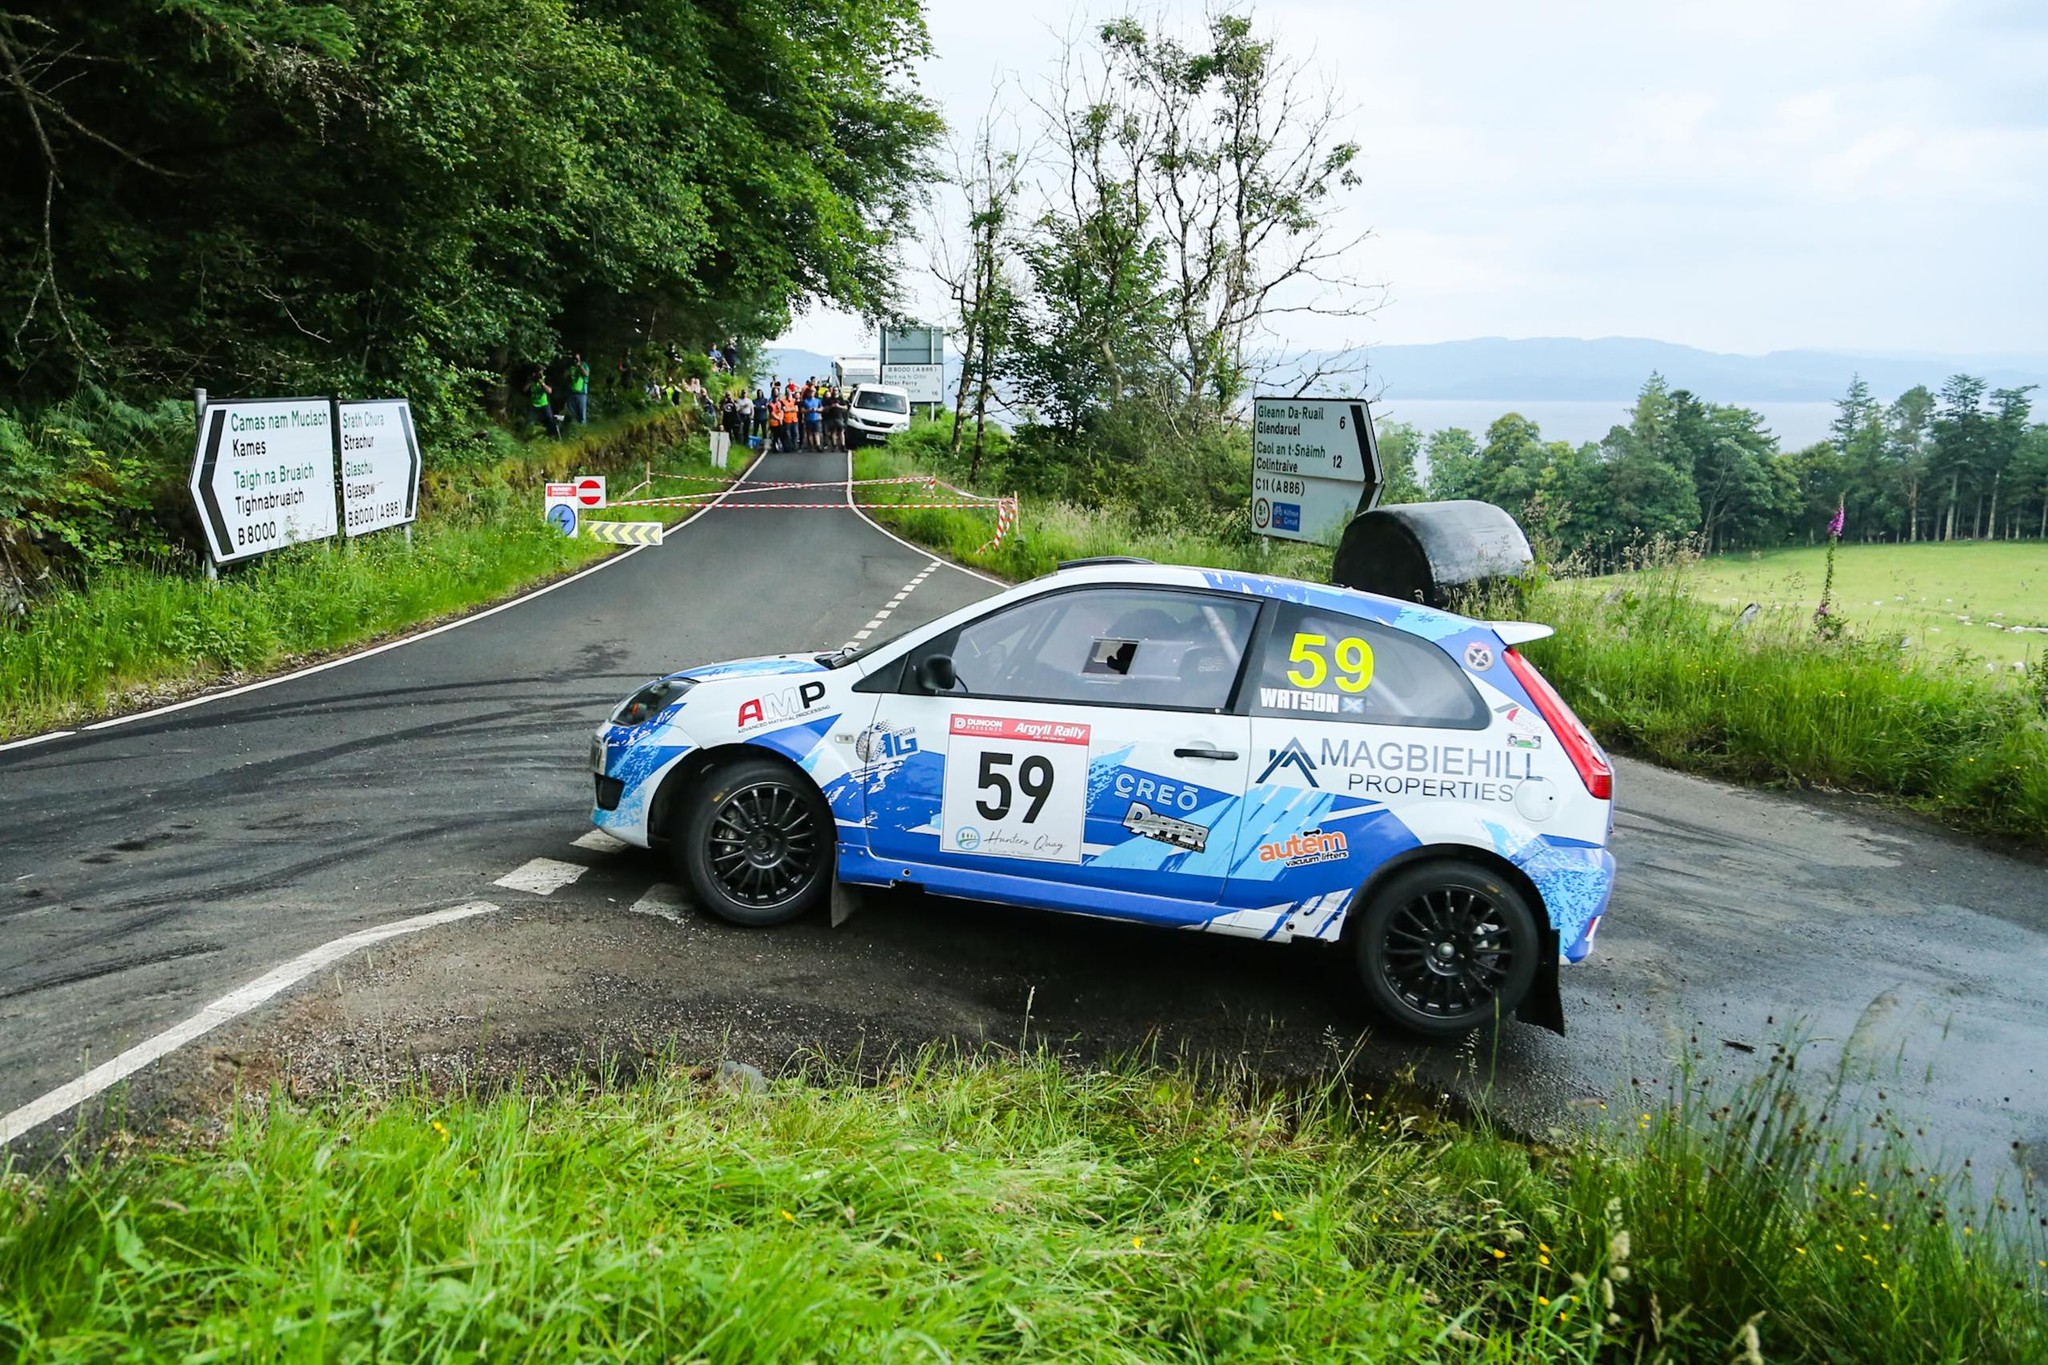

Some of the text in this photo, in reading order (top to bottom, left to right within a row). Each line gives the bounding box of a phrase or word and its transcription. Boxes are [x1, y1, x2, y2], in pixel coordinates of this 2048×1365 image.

[231, 410, 328, 432] Camas nam Muclach
[342, 411, 384, 429] Srath Chura
[1258, 406, 1285, 418] Gleann
[1257, 422, 1300, 436] Glendaruel
[1340, 416, 1346, 430] 6
[232, 439, 266, 458] Kames
[344, 434, 374, 450] Strachur
[1256, 442, 1275, 454] Caol
[1276, 445, 1286, 455] an
[344, 460, 373, 477] Glaschu
[1256, 458, 1298, 473] Colintraive
[1332, 455, 1342, 468] 12
[234, 463, 314, 491] Taigh na Bruaich
[346, 482, 376, 499] Glasgow
[235, 488, 304, 517] Tighnabruaich
[1286, 632, 1375, 693] 59
[738, 681, 826, 727] AMP
[1260, 687, 1339, 714] WATSON
[967, 718, 1003, 728] DUNOON
[1014, 722, 1051, 736] Argyll
[1054, 724, 1086, 739] Rally
[1320, 738, 1544, 781] MAGBIEHILL
[976, 751, 1054, 824] 59
[1348, 773, 1514, 802] PROPERTIES
[1033, 833, 1066, 855] Quay
[1259, 831, 1346, 862] autem
[1285, 851, 1348, 866] vacuum lifters
